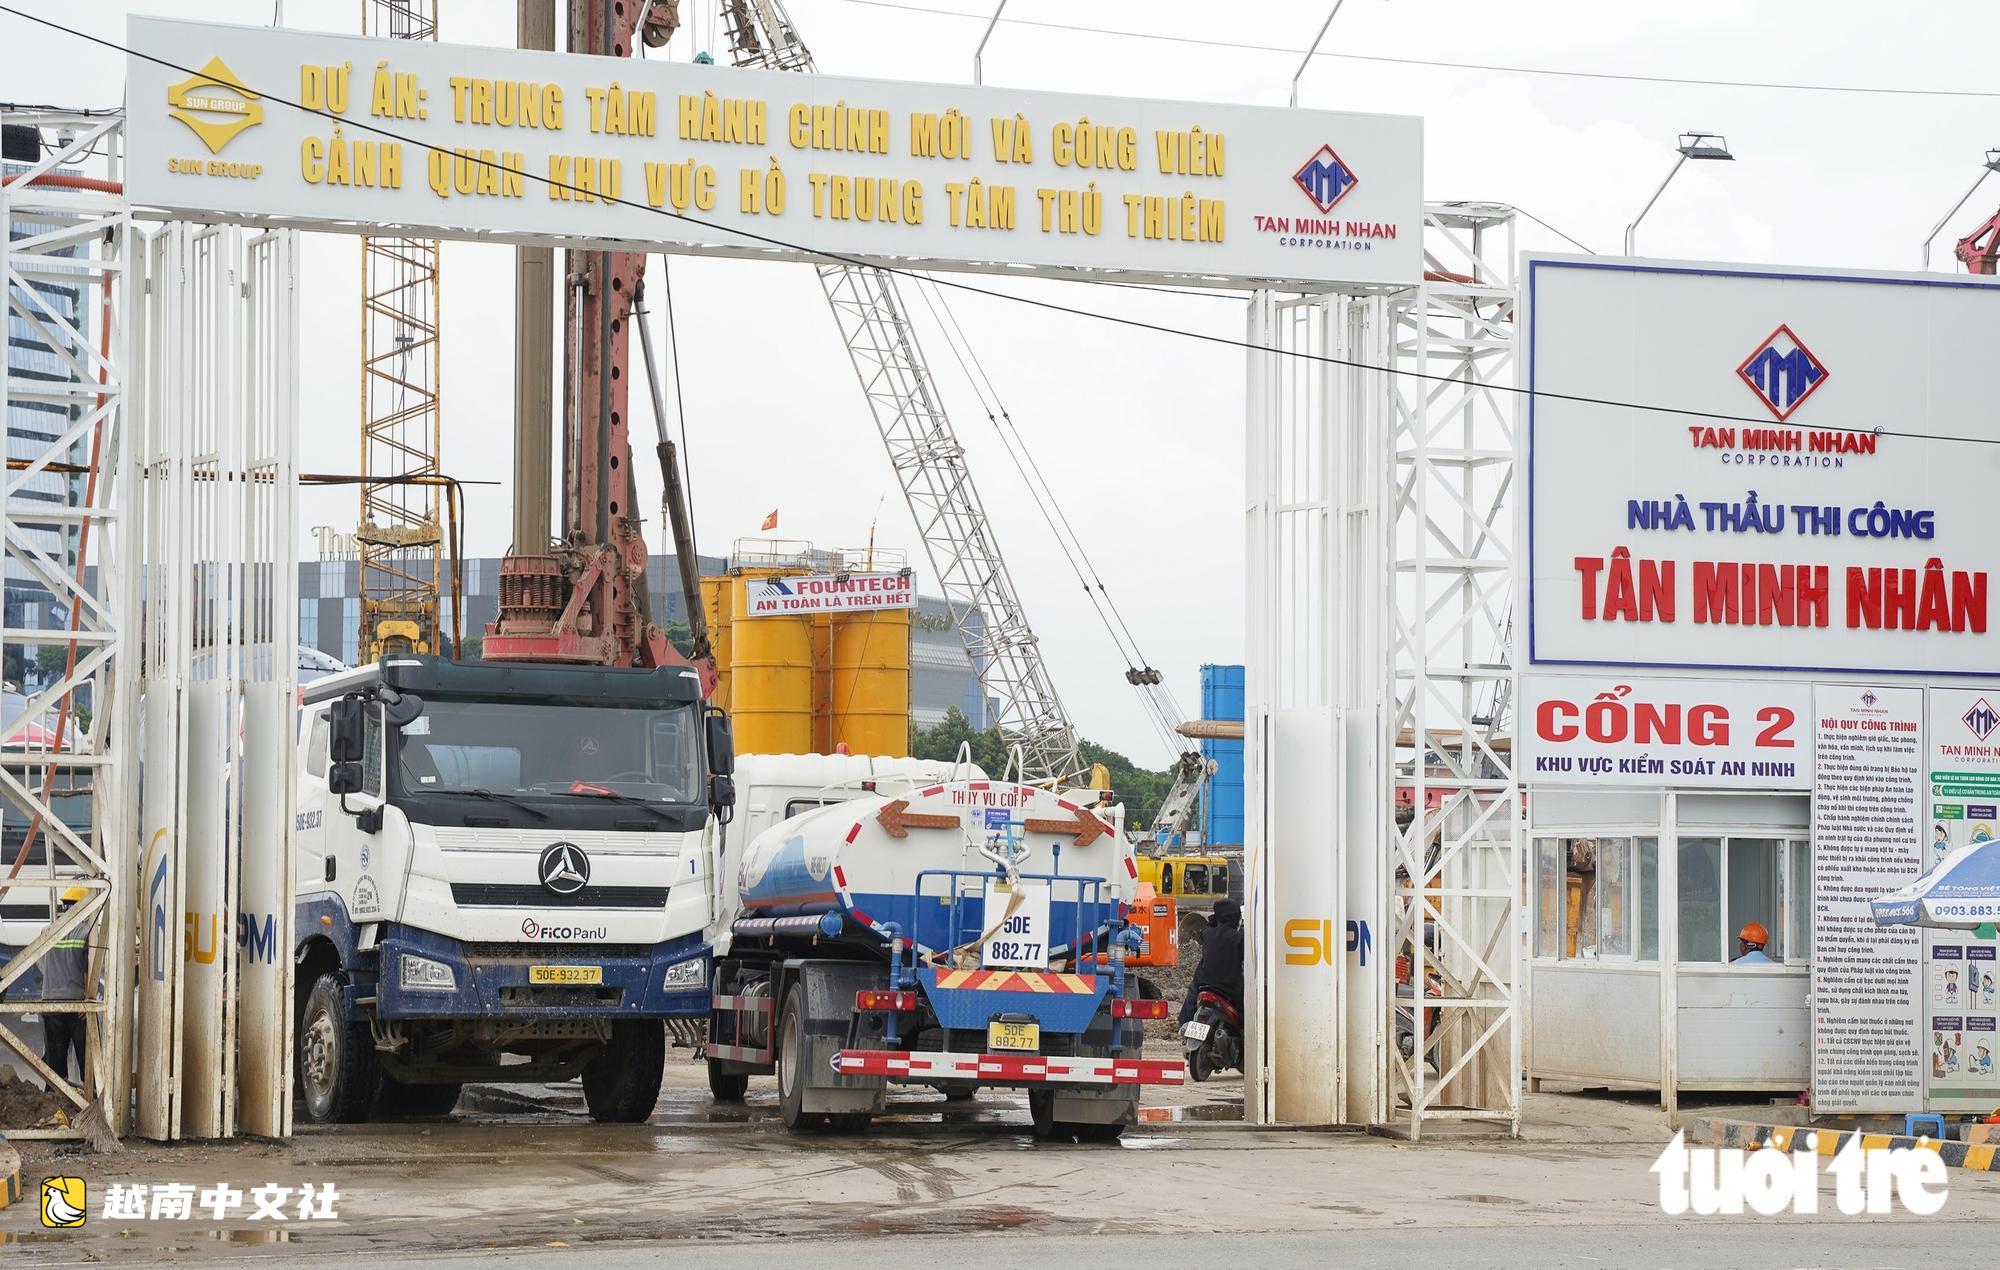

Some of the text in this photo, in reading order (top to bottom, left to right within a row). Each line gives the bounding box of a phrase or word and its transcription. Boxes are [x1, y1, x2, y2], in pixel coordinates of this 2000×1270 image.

[186, 97, 246, 112] SUN GROUP
[300, 60, 1225, 177] DỰ ÁN: TRUNG TÂM HÀNH CHÍNH MỚI VÀ CÔNG VIÊN
[168, 158, 263, 179] SUN GROUP
[300, 127, 1225, 243] CẢNH QUAN KHU VỰC HỒ TRUNG TÂM THỦ THIÊM
[1254, 215, 1397, 240] TAN MINH NHAN
[1279, 237, 1371, 251] CORPORATION
[1689, 426, 1876, 454] TAN MINH NHAN
[1721, 453, 1844, 468] CORPORATION
[1628, 490, 1935, 540] NHÀ THẦU THI CÔNG
[797, 577, 910, 594] FOUNTECH
[1574, 546, 1987, 633] TÂN MINH NHÂN
[756, 601, 776, 610] AN
[825, 595, 842, 607] LÀ
[847, 593, 881, 606] TRÊN
[887, 590, 911, 605] HẾT
[1537, 685, 1795, 748] CỔNG 2
[1821, 718, 1917, 732] NỘI QUY CÔNG TRÌNH
[1940, 745, 1961, 755] TAN
[1964, 746, 1991, 756] MINH
[1536, 753, 1795, 777] KHU VỰC KIỂM SOÁT AN NINH
[689, 859, 695, 875] 1
[1935, 906, 2000, 916] 0903.883.5
[1004, 916, 1031, 934] 50E
[992, 942, 1041, 960] 882.77
[1004, 1025, 1025, 1036] 50E
[996, 1036, 1033, 1048] 882.77
